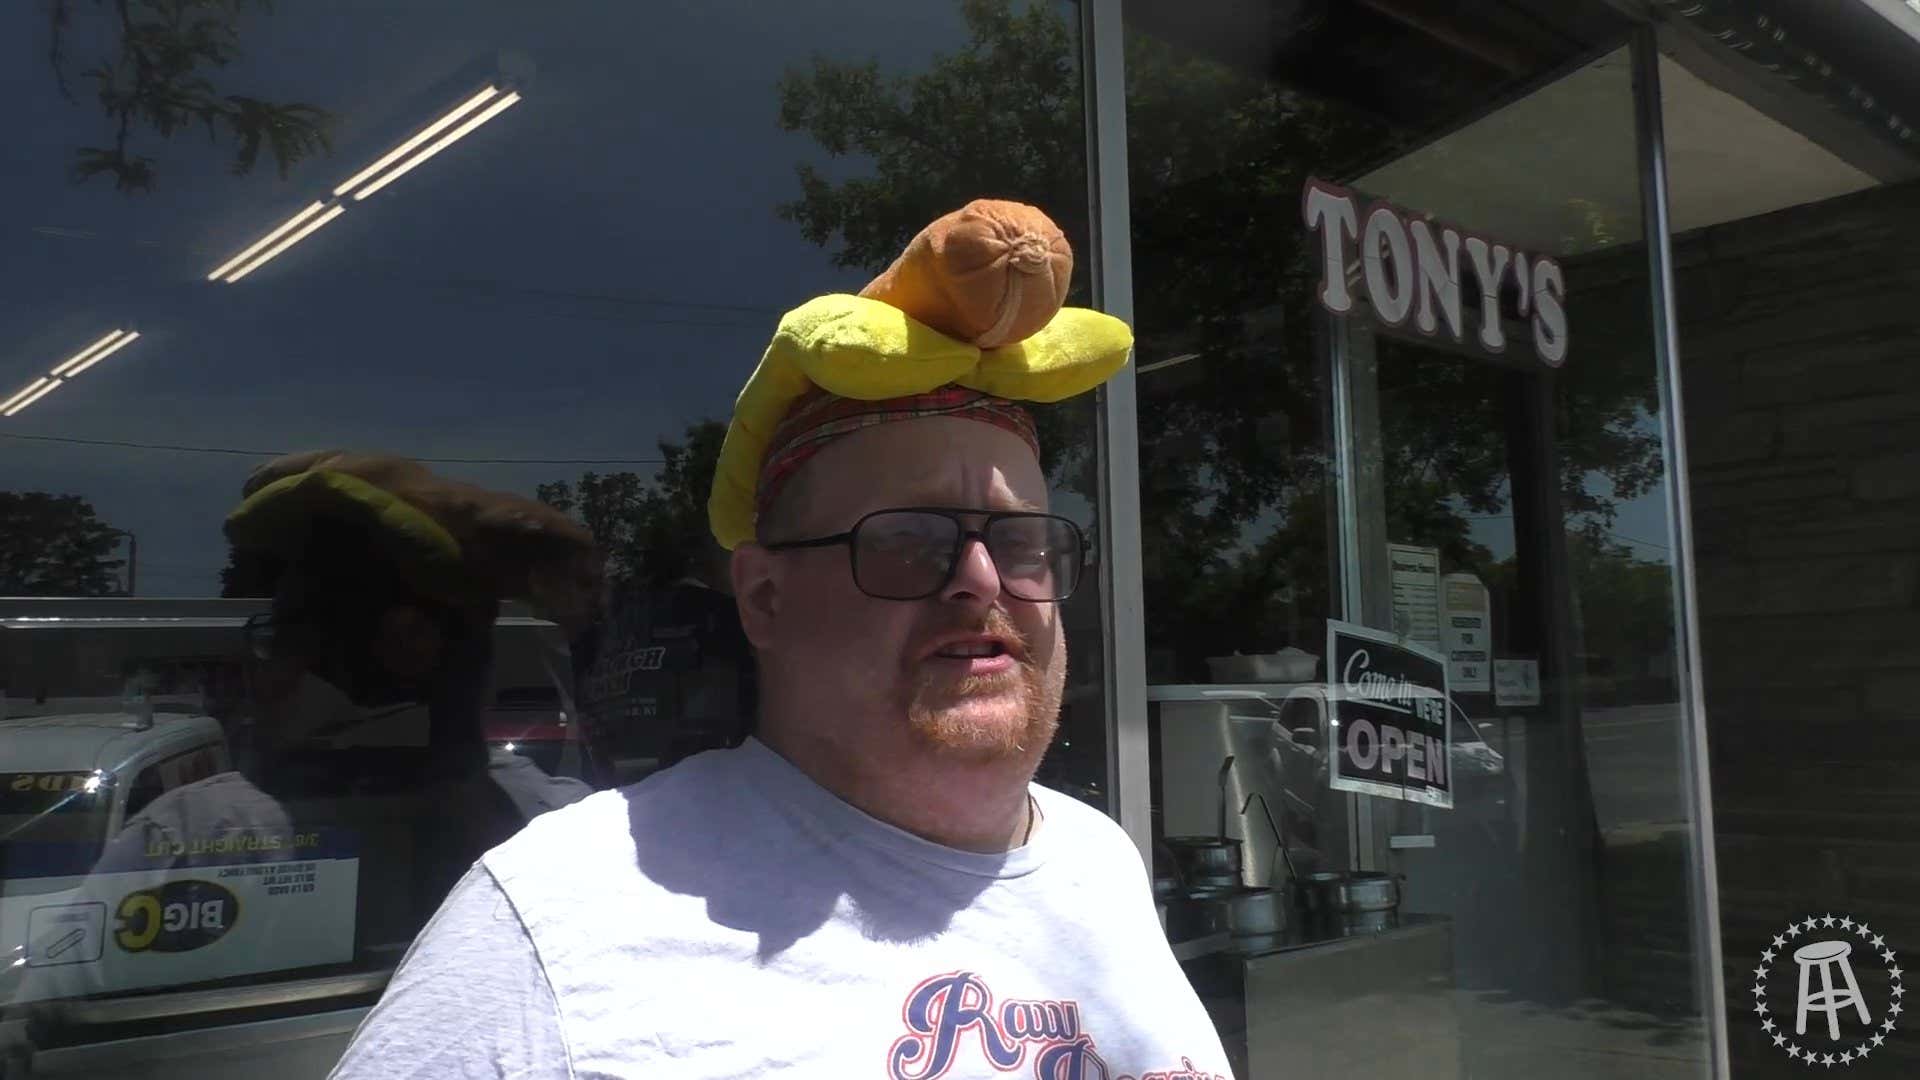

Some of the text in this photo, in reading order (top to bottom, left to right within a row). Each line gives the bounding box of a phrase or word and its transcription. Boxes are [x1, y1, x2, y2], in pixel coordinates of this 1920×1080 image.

[1303, 177, 1568, 368] TONY'S
[1346, 649, 1412, 707] Come in
[1346, 718, 1444, 784] OPEN
[189, 836, 282, 855] STRAIGHT
[164, 898, 225, 932] BIG
[888, 970, 1083, 1080] Raw
